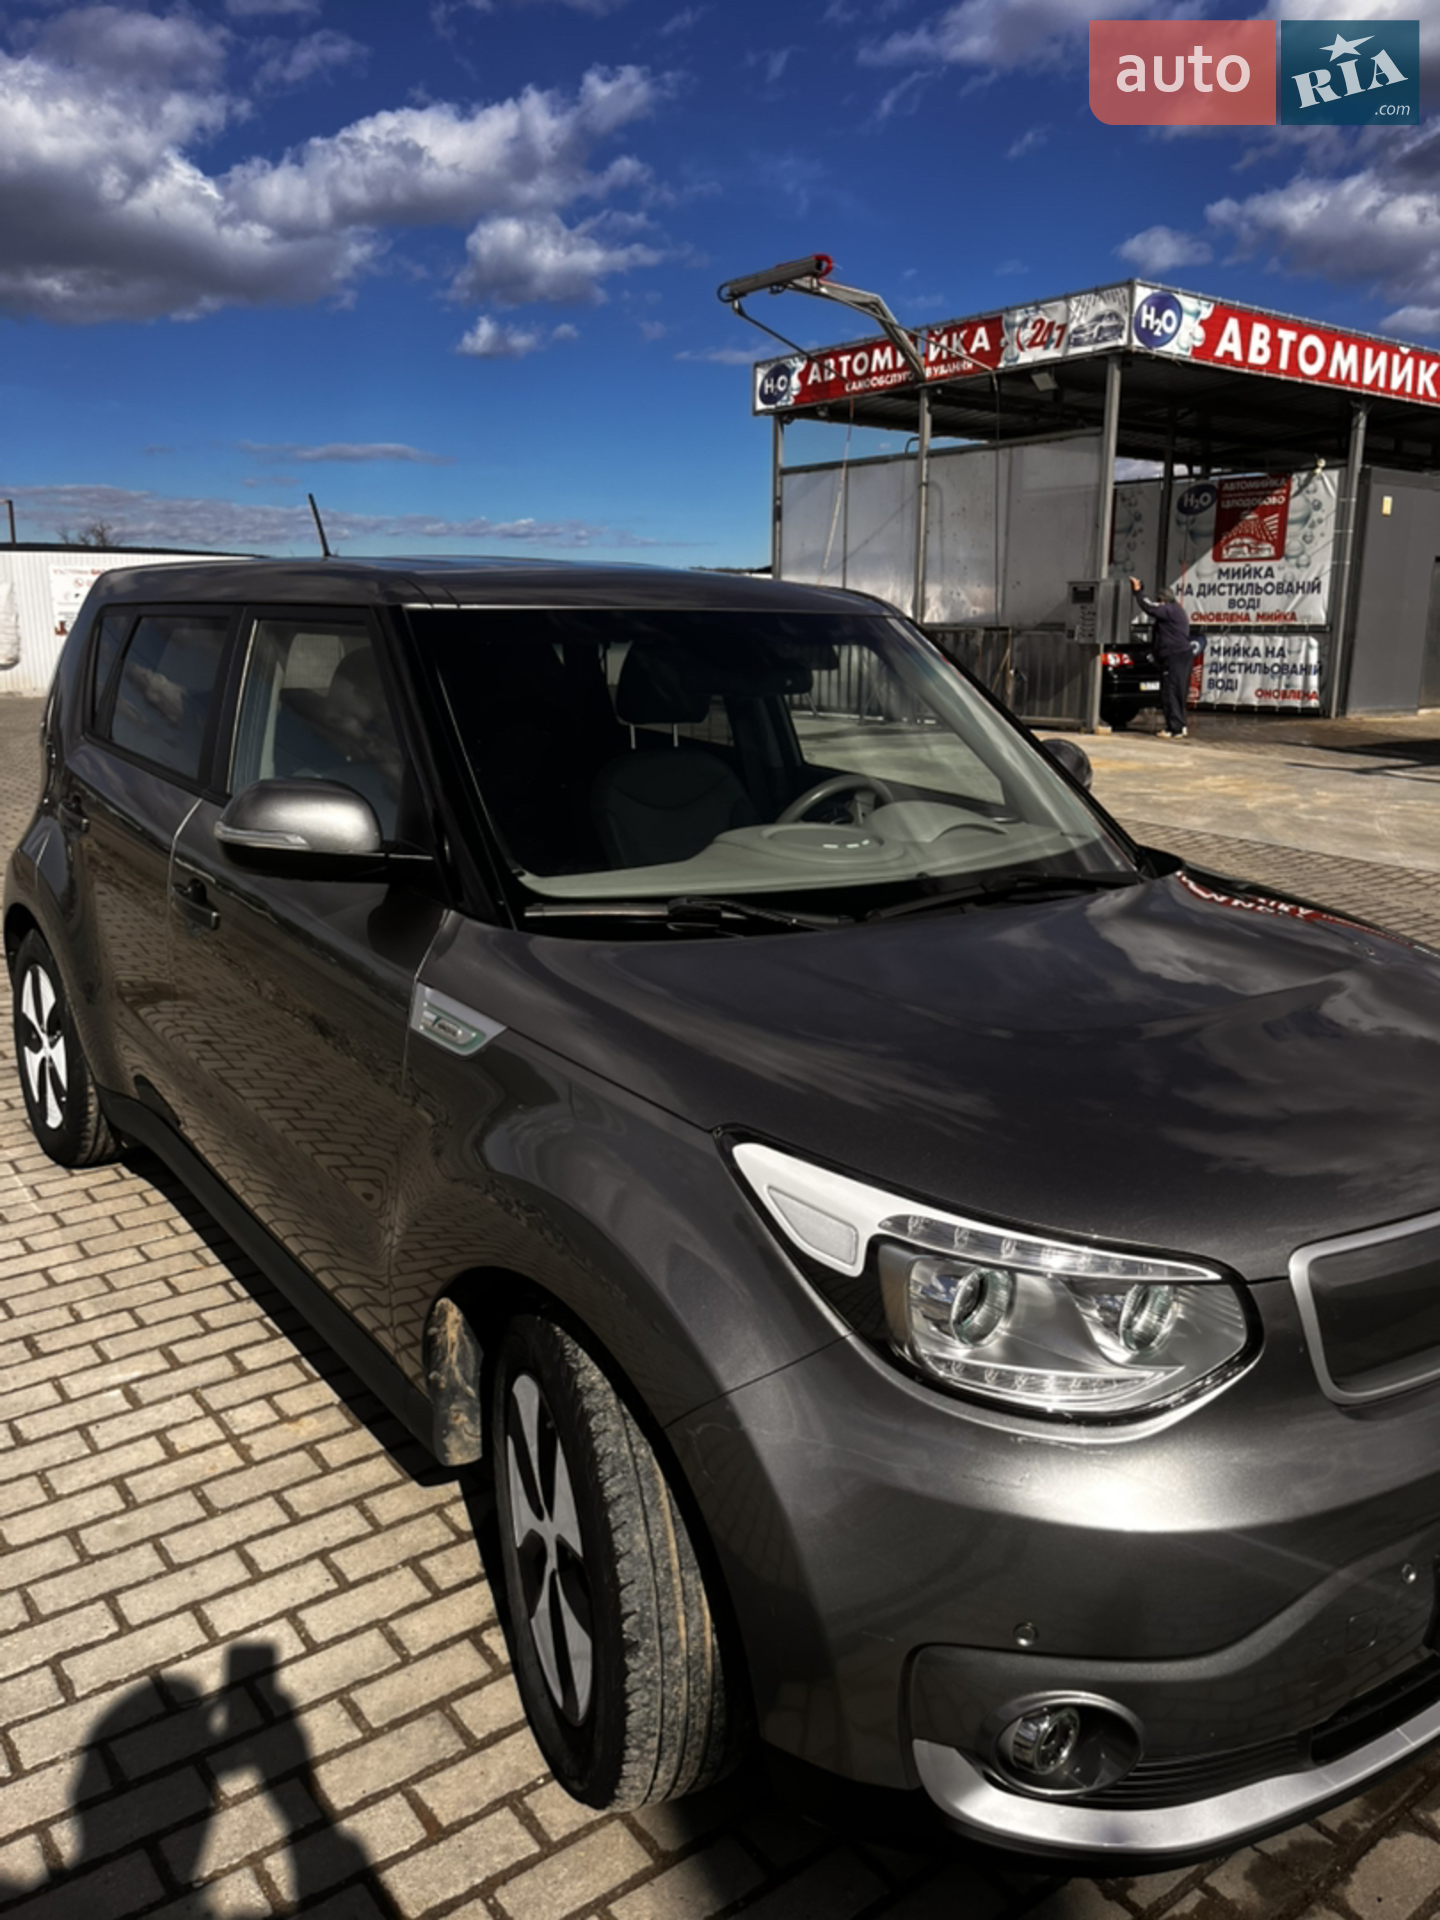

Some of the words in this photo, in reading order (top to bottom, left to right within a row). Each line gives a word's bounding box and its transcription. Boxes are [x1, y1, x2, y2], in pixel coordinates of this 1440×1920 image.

[1217, 564, 1275, 580] МИЙКА
[1176, 584, 1194, 596] НА
[1197, 577, 1321, 598] ДИСТИЛЬОВАНІЙ
[1228, 597, 1260, 609] ВОДІ
[1191, 611, 1250, 622] ОНОВЛЕНА
[1256, 609, 1297, 622] МИЙКА
[1210, 644, 1259, 658] МИЙКА
[1265, 648, 1286, 658] НА
[1209, 660, 1322, 676] ДИСТИЛЬОВАНІЙ
[1208, 678, 1238, 691] ВОДІ
